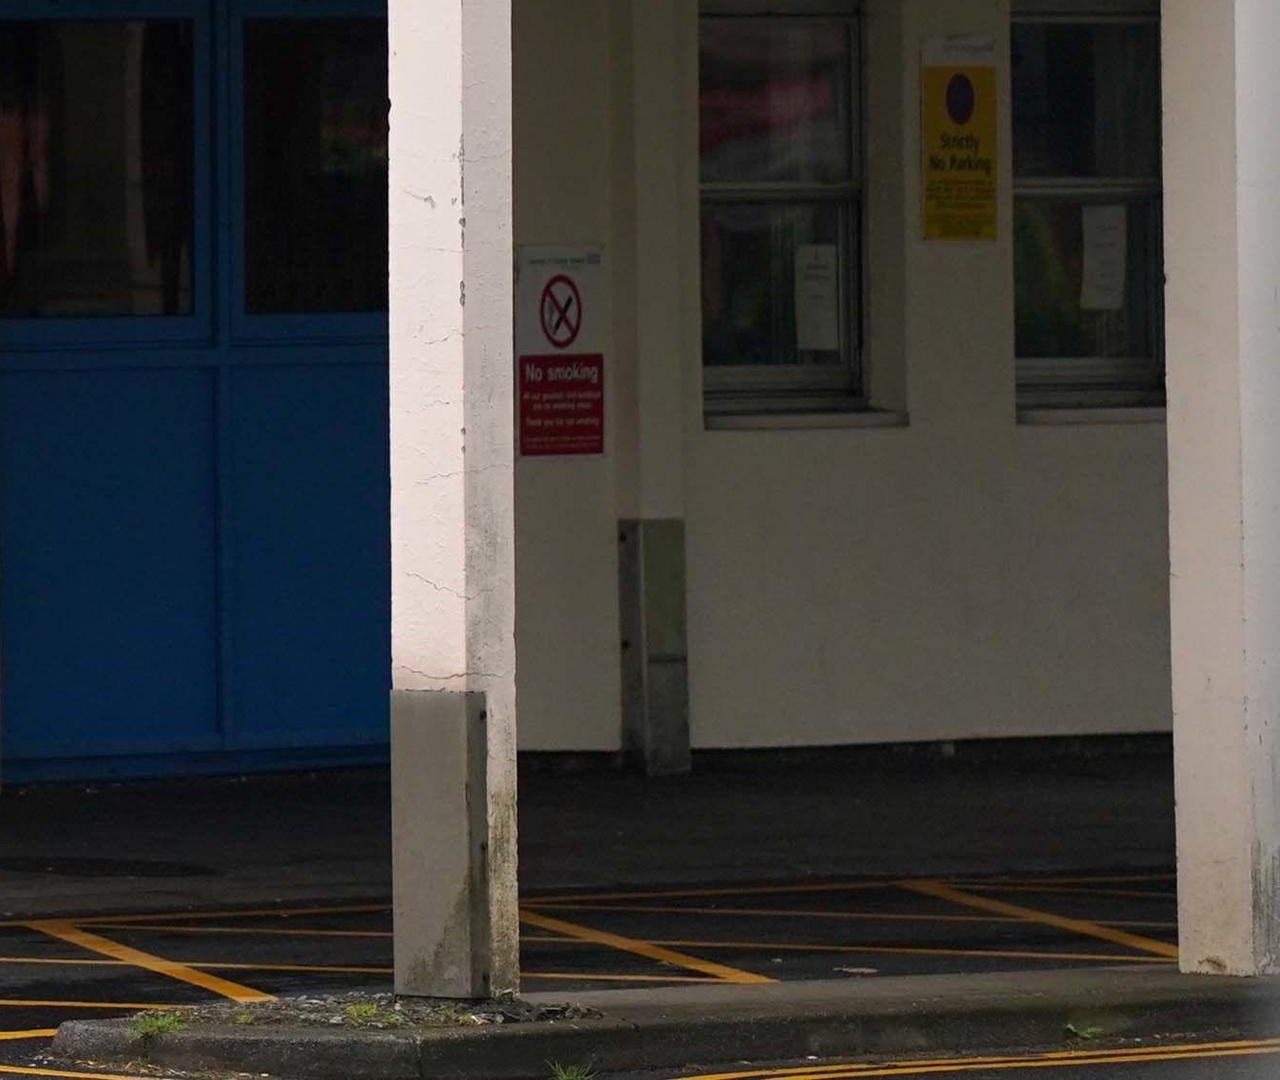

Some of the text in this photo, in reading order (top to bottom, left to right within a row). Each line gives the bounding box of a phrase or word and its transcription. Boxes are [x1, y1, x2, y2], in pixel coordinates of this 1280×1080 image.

[939, 131, 981, 157] Strictly
[929, 154, 992, 177] No Parking
[524, 362, 599, 384] No smoking
